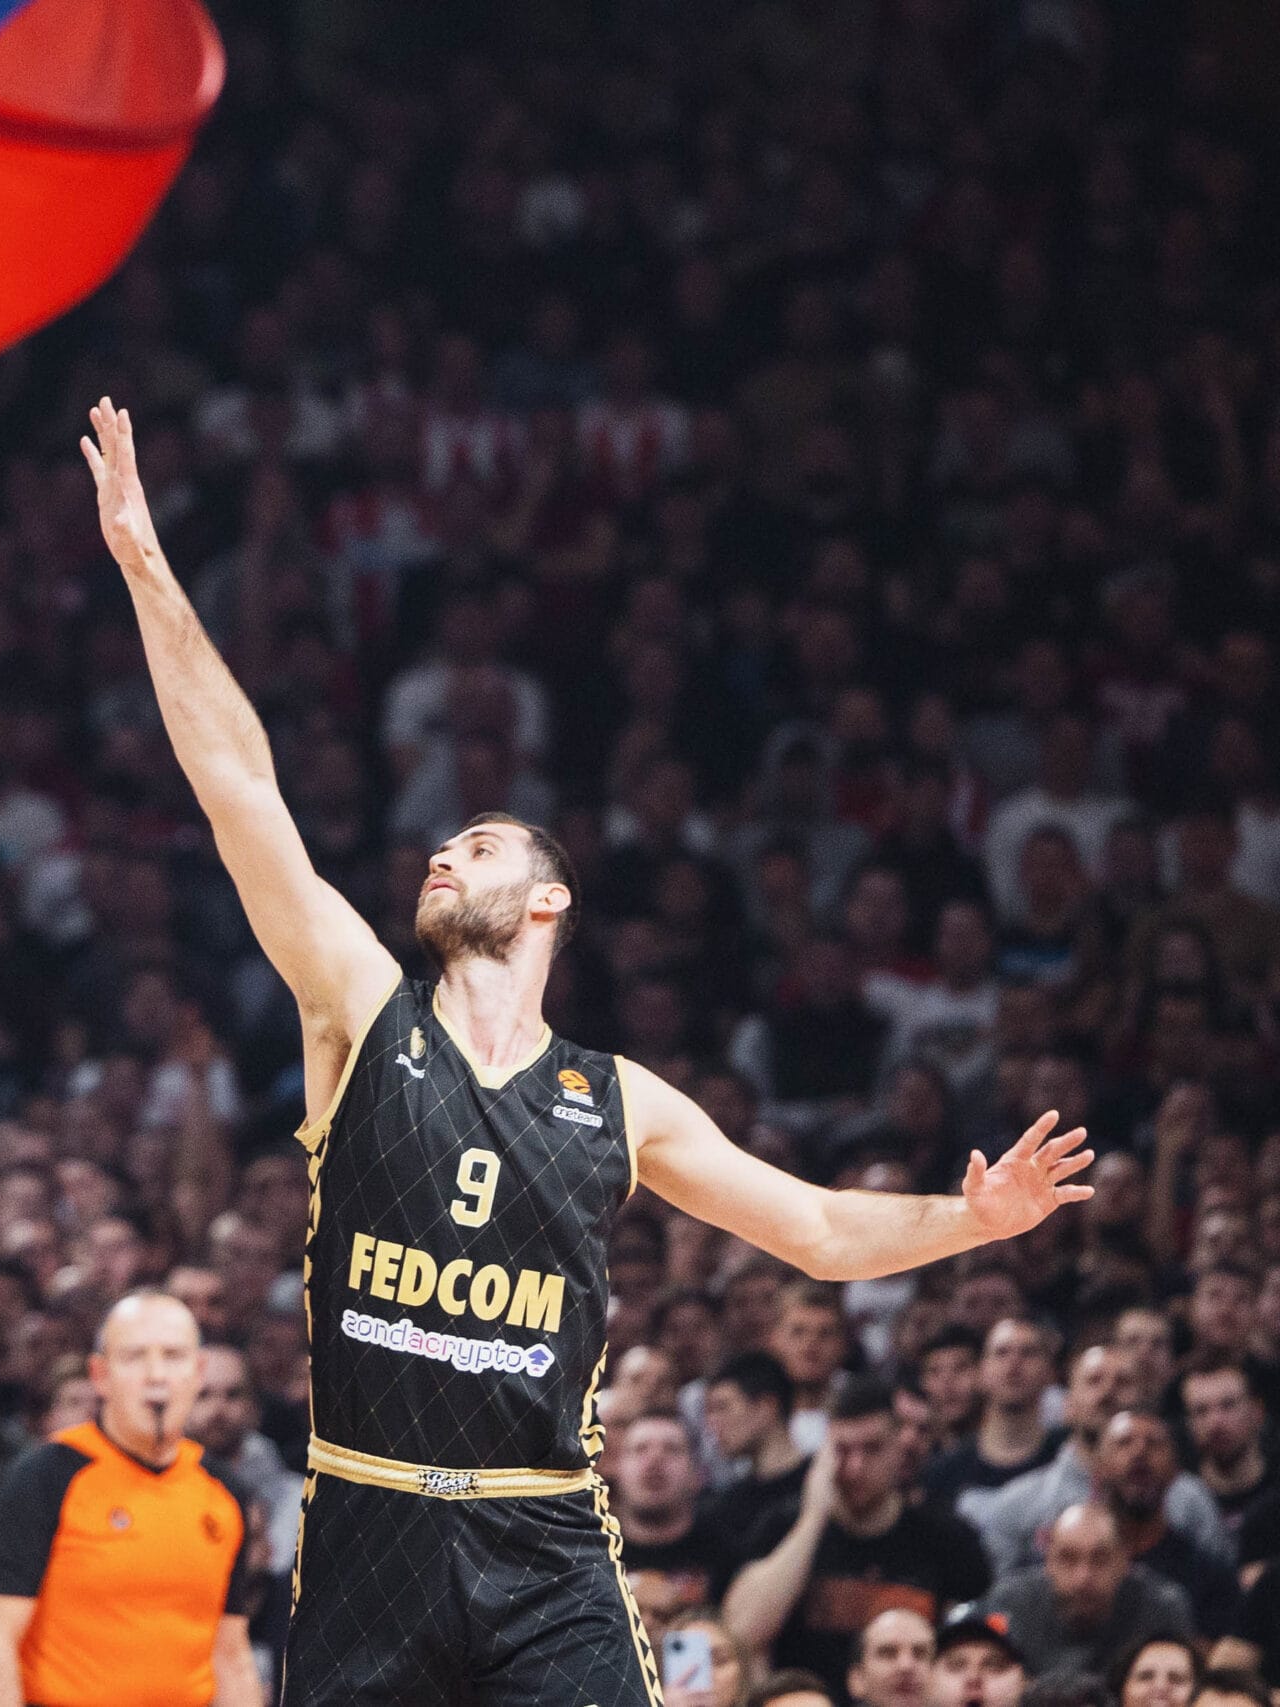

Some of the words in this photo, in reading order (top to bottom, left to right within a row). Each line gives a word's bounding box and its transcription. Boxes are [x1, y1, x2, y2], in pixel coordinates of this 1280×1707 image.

[450, 1147, 501, 1228] 9
[348, 1231, 566, 1334] FEDCOM
[344, 1312, 522, 1369] zondacrypto
